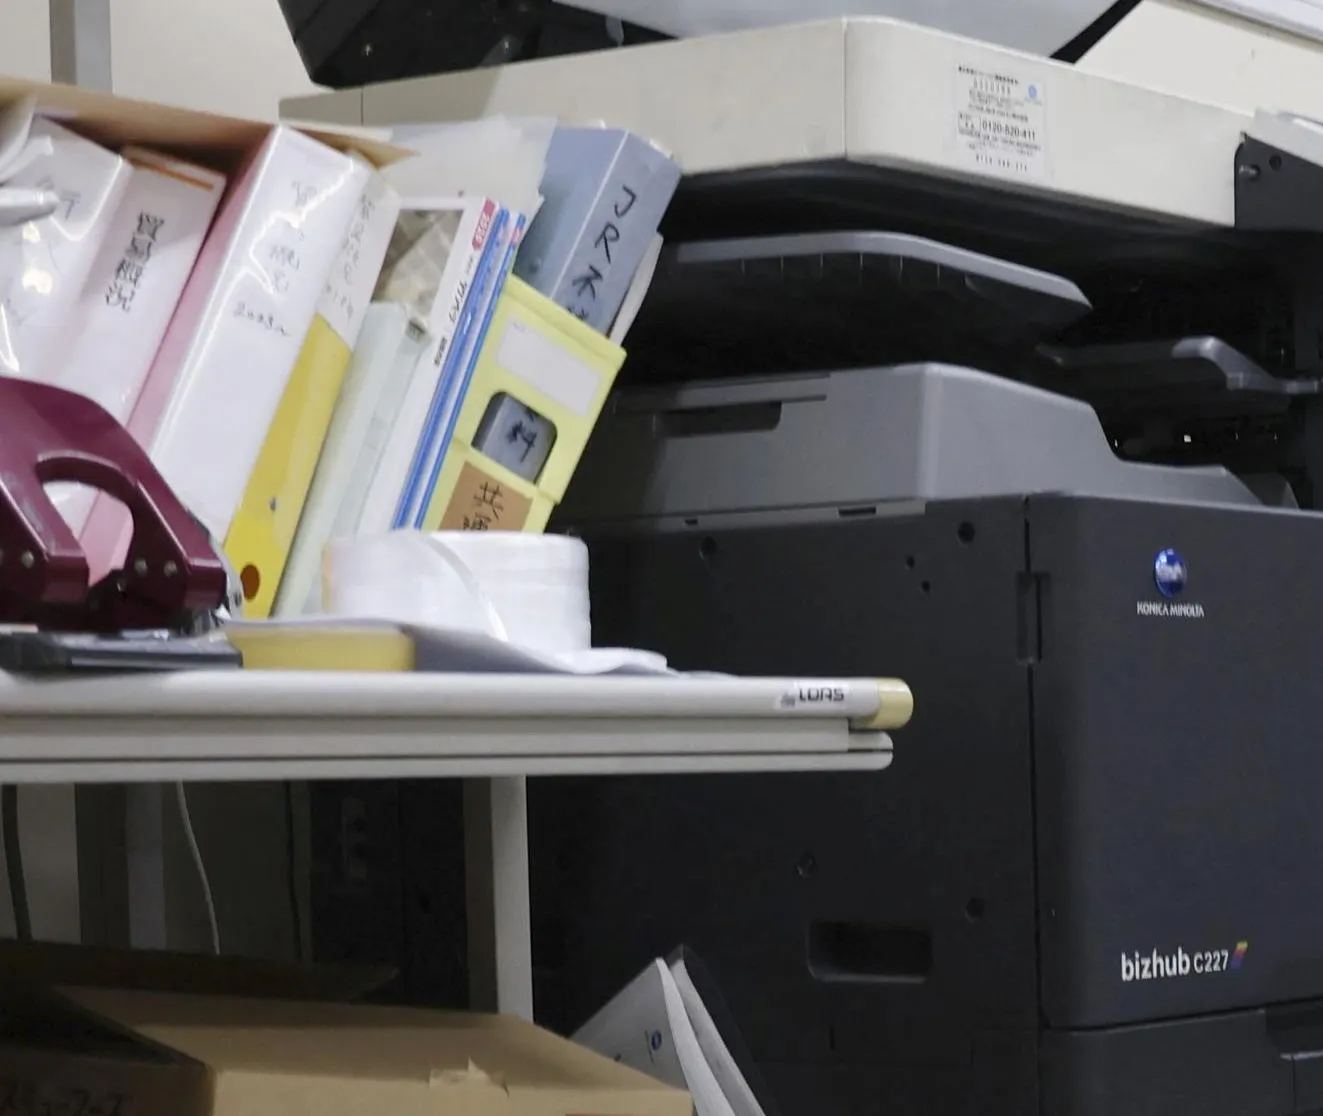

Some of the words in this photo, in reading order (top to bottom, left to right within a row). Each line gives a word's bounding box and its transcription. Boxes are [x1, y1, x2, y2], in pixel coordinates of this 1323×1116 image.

[1136, 602, 1168, 616] KONICA
[1169, 604, 1205, 618] MINOLTA
[1121, 940, 1190, 981] bizhub
[1193, 949, 1230, 974] C227
